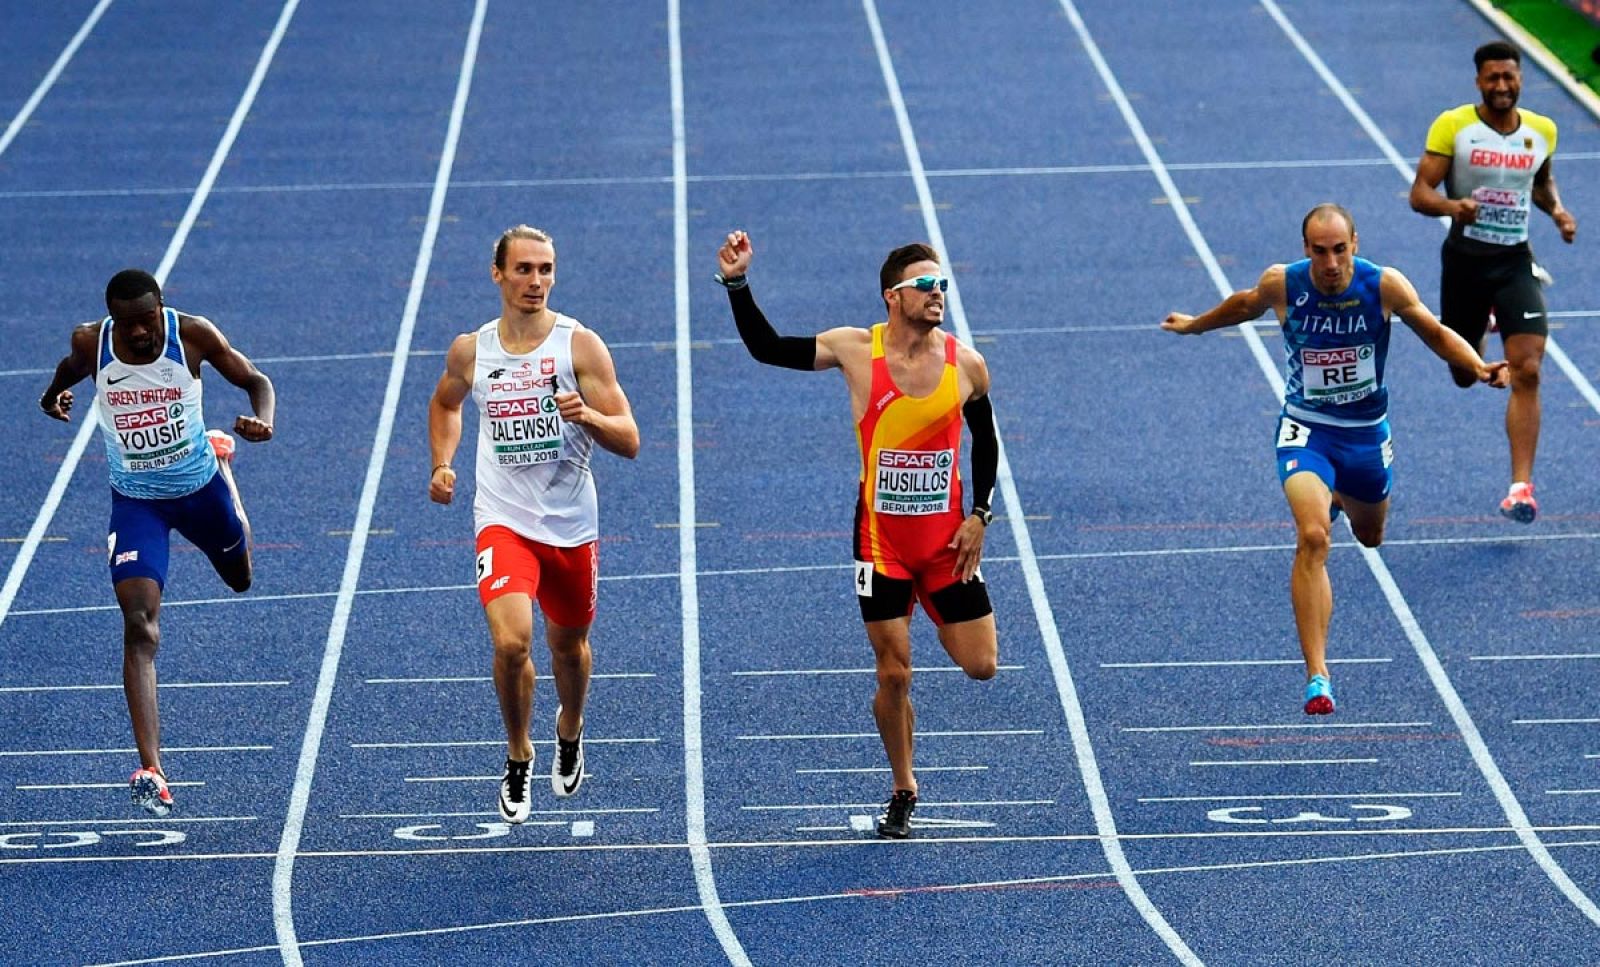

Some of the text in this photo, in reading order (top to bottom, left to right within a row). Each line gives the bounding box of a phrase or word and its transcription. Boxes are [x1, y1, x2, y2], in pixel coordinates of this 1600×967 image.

[1471, 149, 1534, 169] GERMANY
[1475, 189, 1516, 205] SPAR
[1477, 205, 1528, 224] CHNEIDER
[1302, 315, 1368, 334] ITALIA
[1304, 350, 1356, 364] SPAR
[1323, 365, 1358, 386] RE
[107, 387, 182, 406] GREAT BRITAIN
[488, 401, 538, 416] SPAR
[115, 410, 168, 429] SPAR
[491, 416, 560, 442] ZALEWSKI
[119, 420, 185, 450] YOUSIF
[1285, 424, 1300, 441] 3
[130, 448, 189, 470] BERLIN 2018
[499, 450, 559, 465] BERLIN 2018
[880, 453, 935, 467] SPAR
[878, 470, 949, 492] HUSILLOS
[881, 502, 943, 513] BERLIN 2018
[858, 567, 866, 590] 4
